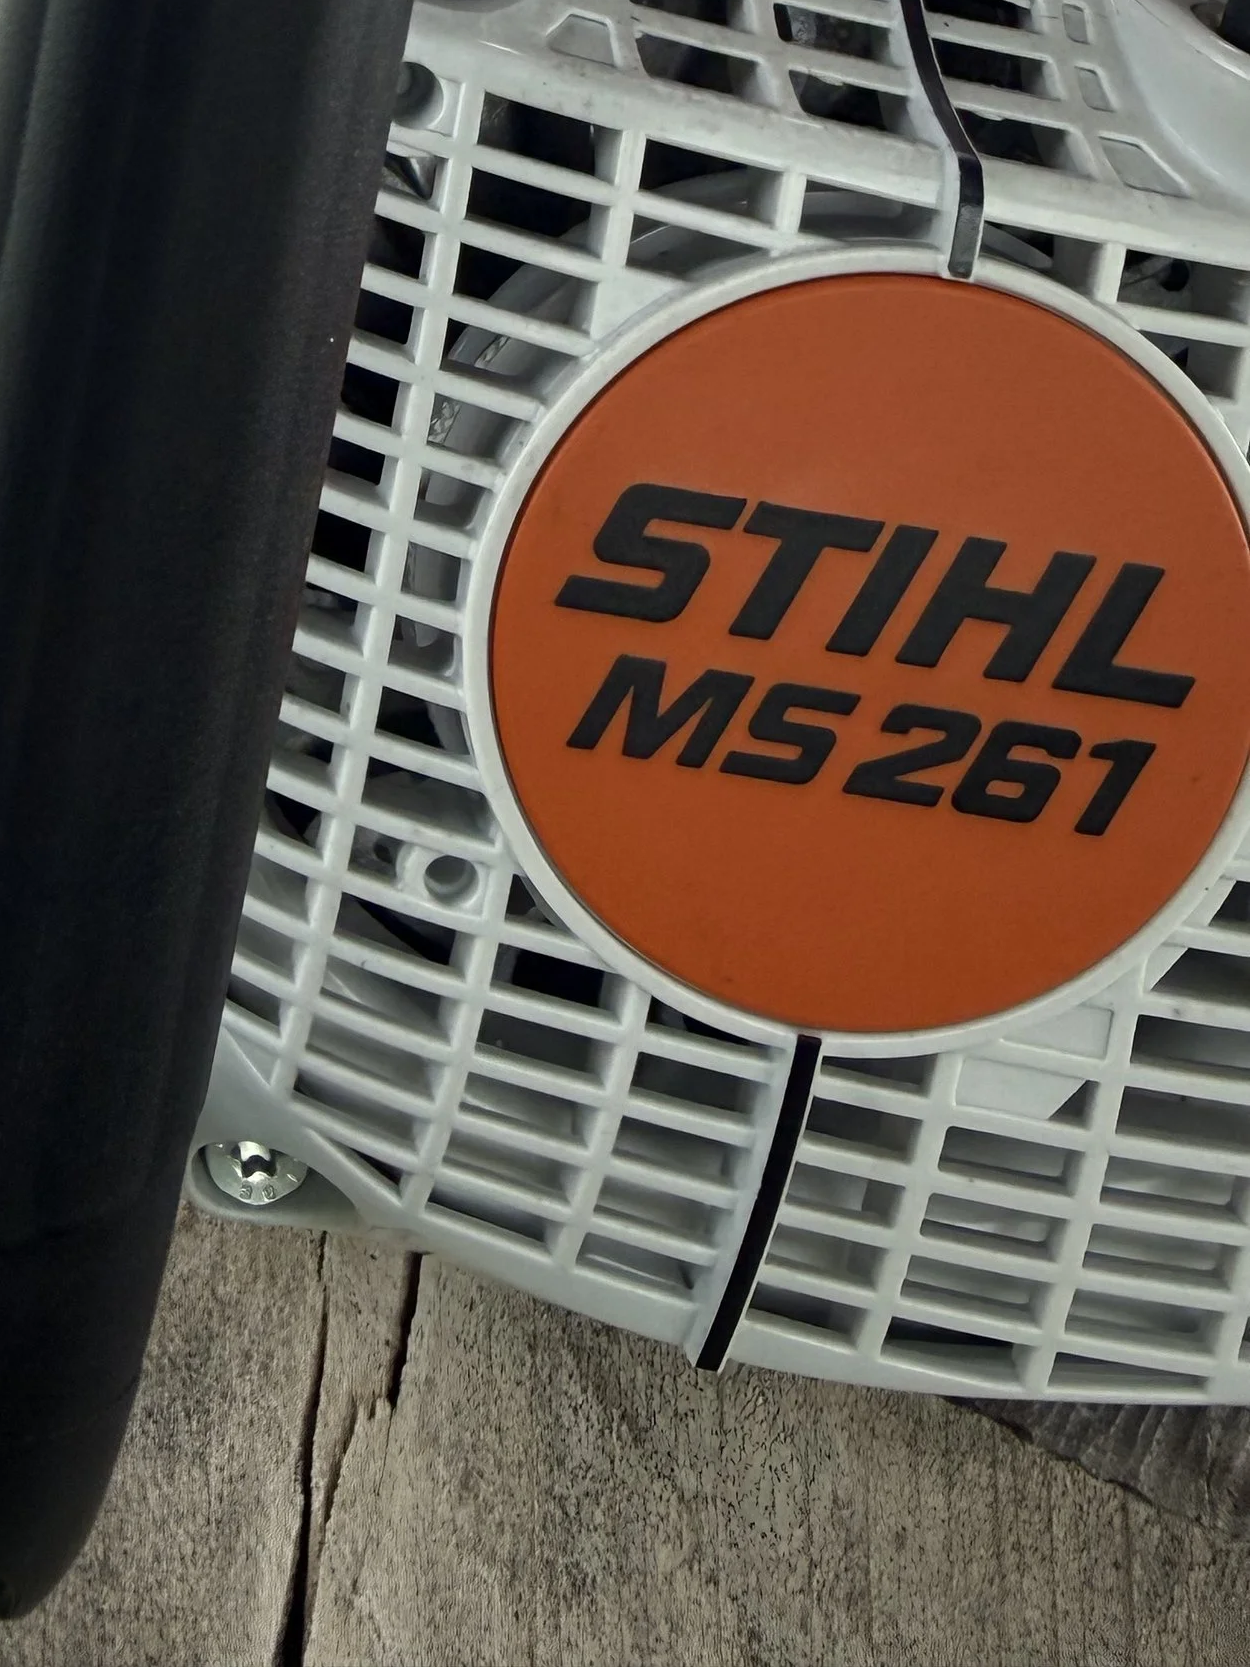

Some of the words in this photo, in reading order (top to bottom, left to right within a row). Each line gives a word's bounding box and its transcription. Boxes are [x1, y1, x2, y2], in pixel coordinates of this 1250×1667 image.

[554, 483, 1196, 709] STIHL
[566, 654, 862, 786] MS
[842, 703, 1156, 837] 261
